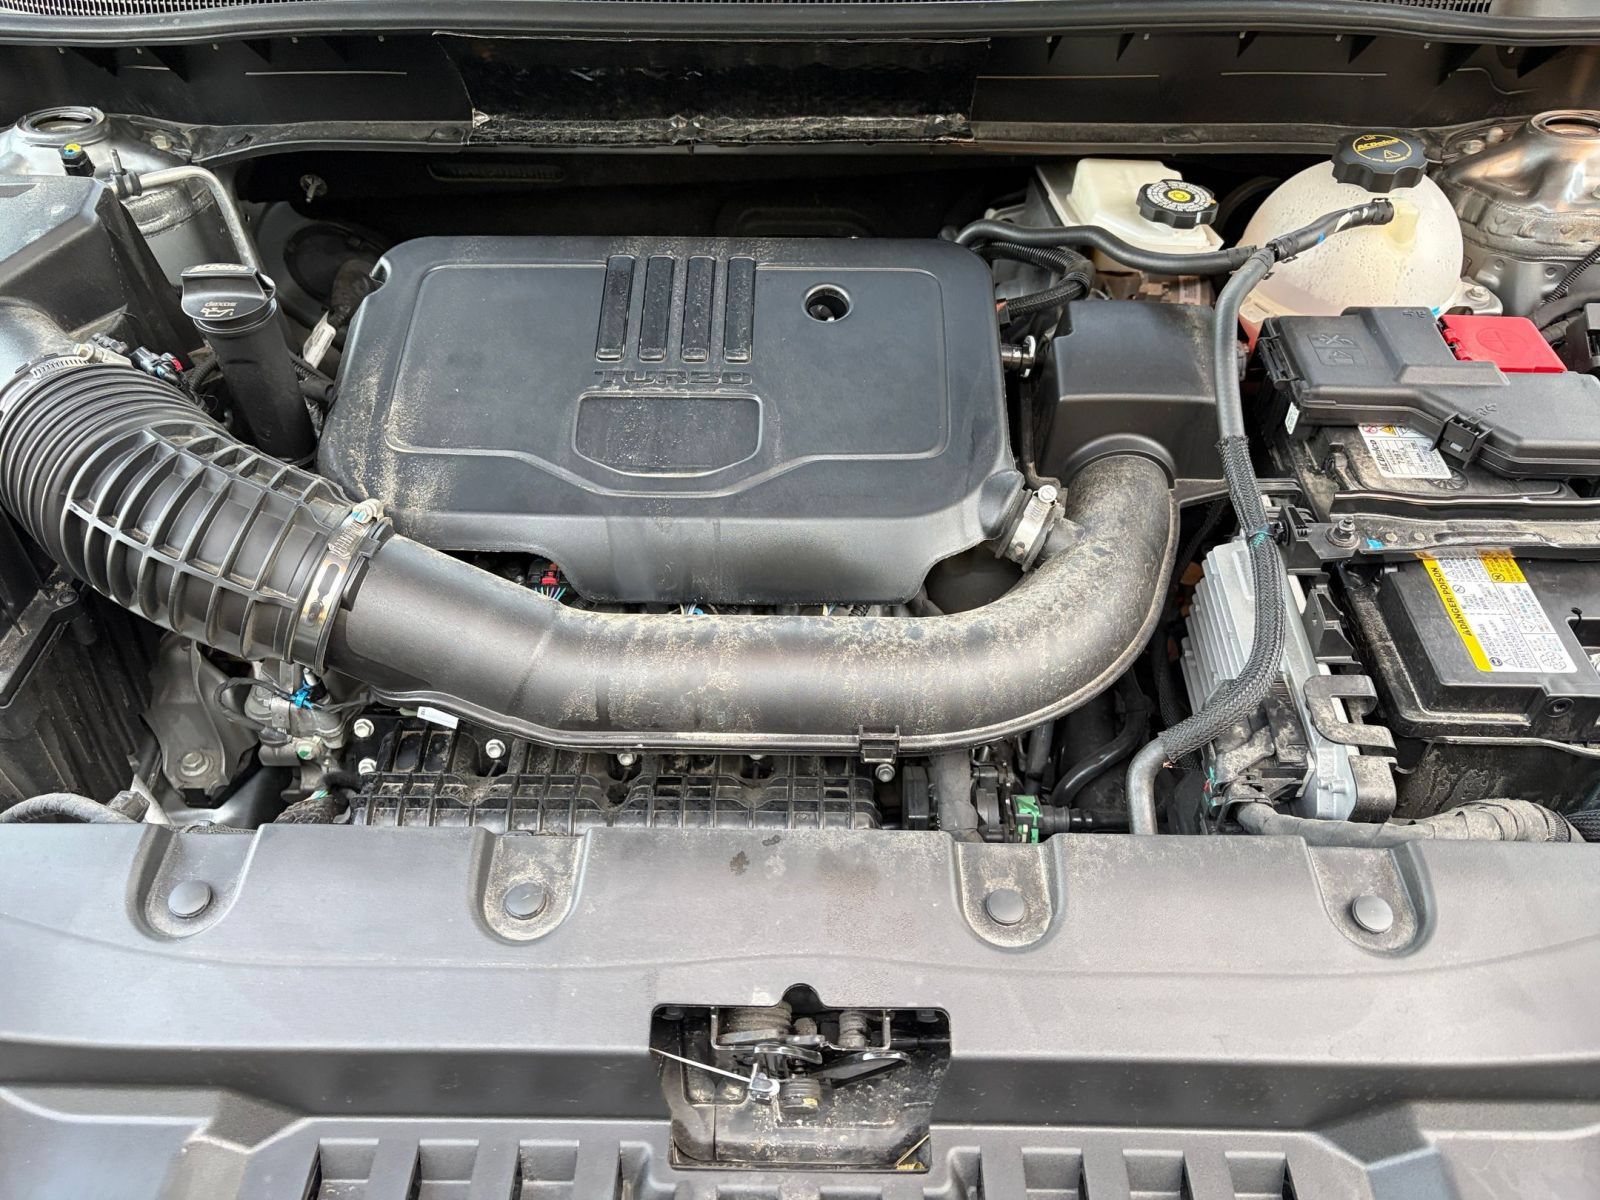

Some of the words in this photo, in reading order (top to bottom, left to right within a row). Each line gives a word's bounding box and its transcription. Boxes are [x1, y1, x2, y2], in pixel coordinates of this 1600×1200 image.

[1357, 139, 1399, 152] ACDelco
[594, 369, 753, 386] TURBO
[1369, 440, 1391, 473] ACDelco
